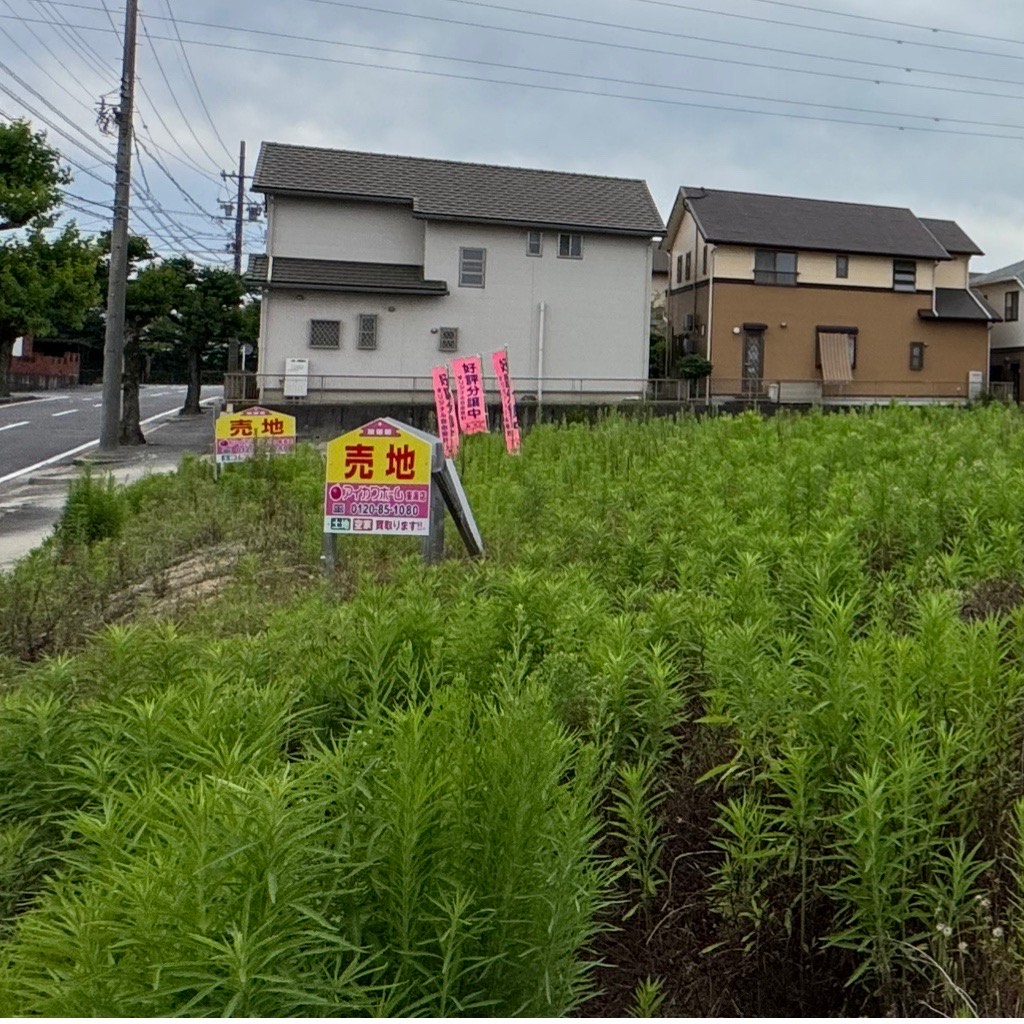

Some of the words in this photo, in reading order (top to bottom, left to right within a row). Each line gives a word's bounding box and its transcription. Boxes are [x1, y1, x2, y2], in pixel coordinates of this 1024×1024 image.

[462, 363, 481, 419] 好評分譲中
[229, 418, 285, 437] 売地
[344, 443, 416, 480] 売地
[342, 484, 405, 502] アイカワホーム
[350, 502, 419, 516] 0120-85-1080
